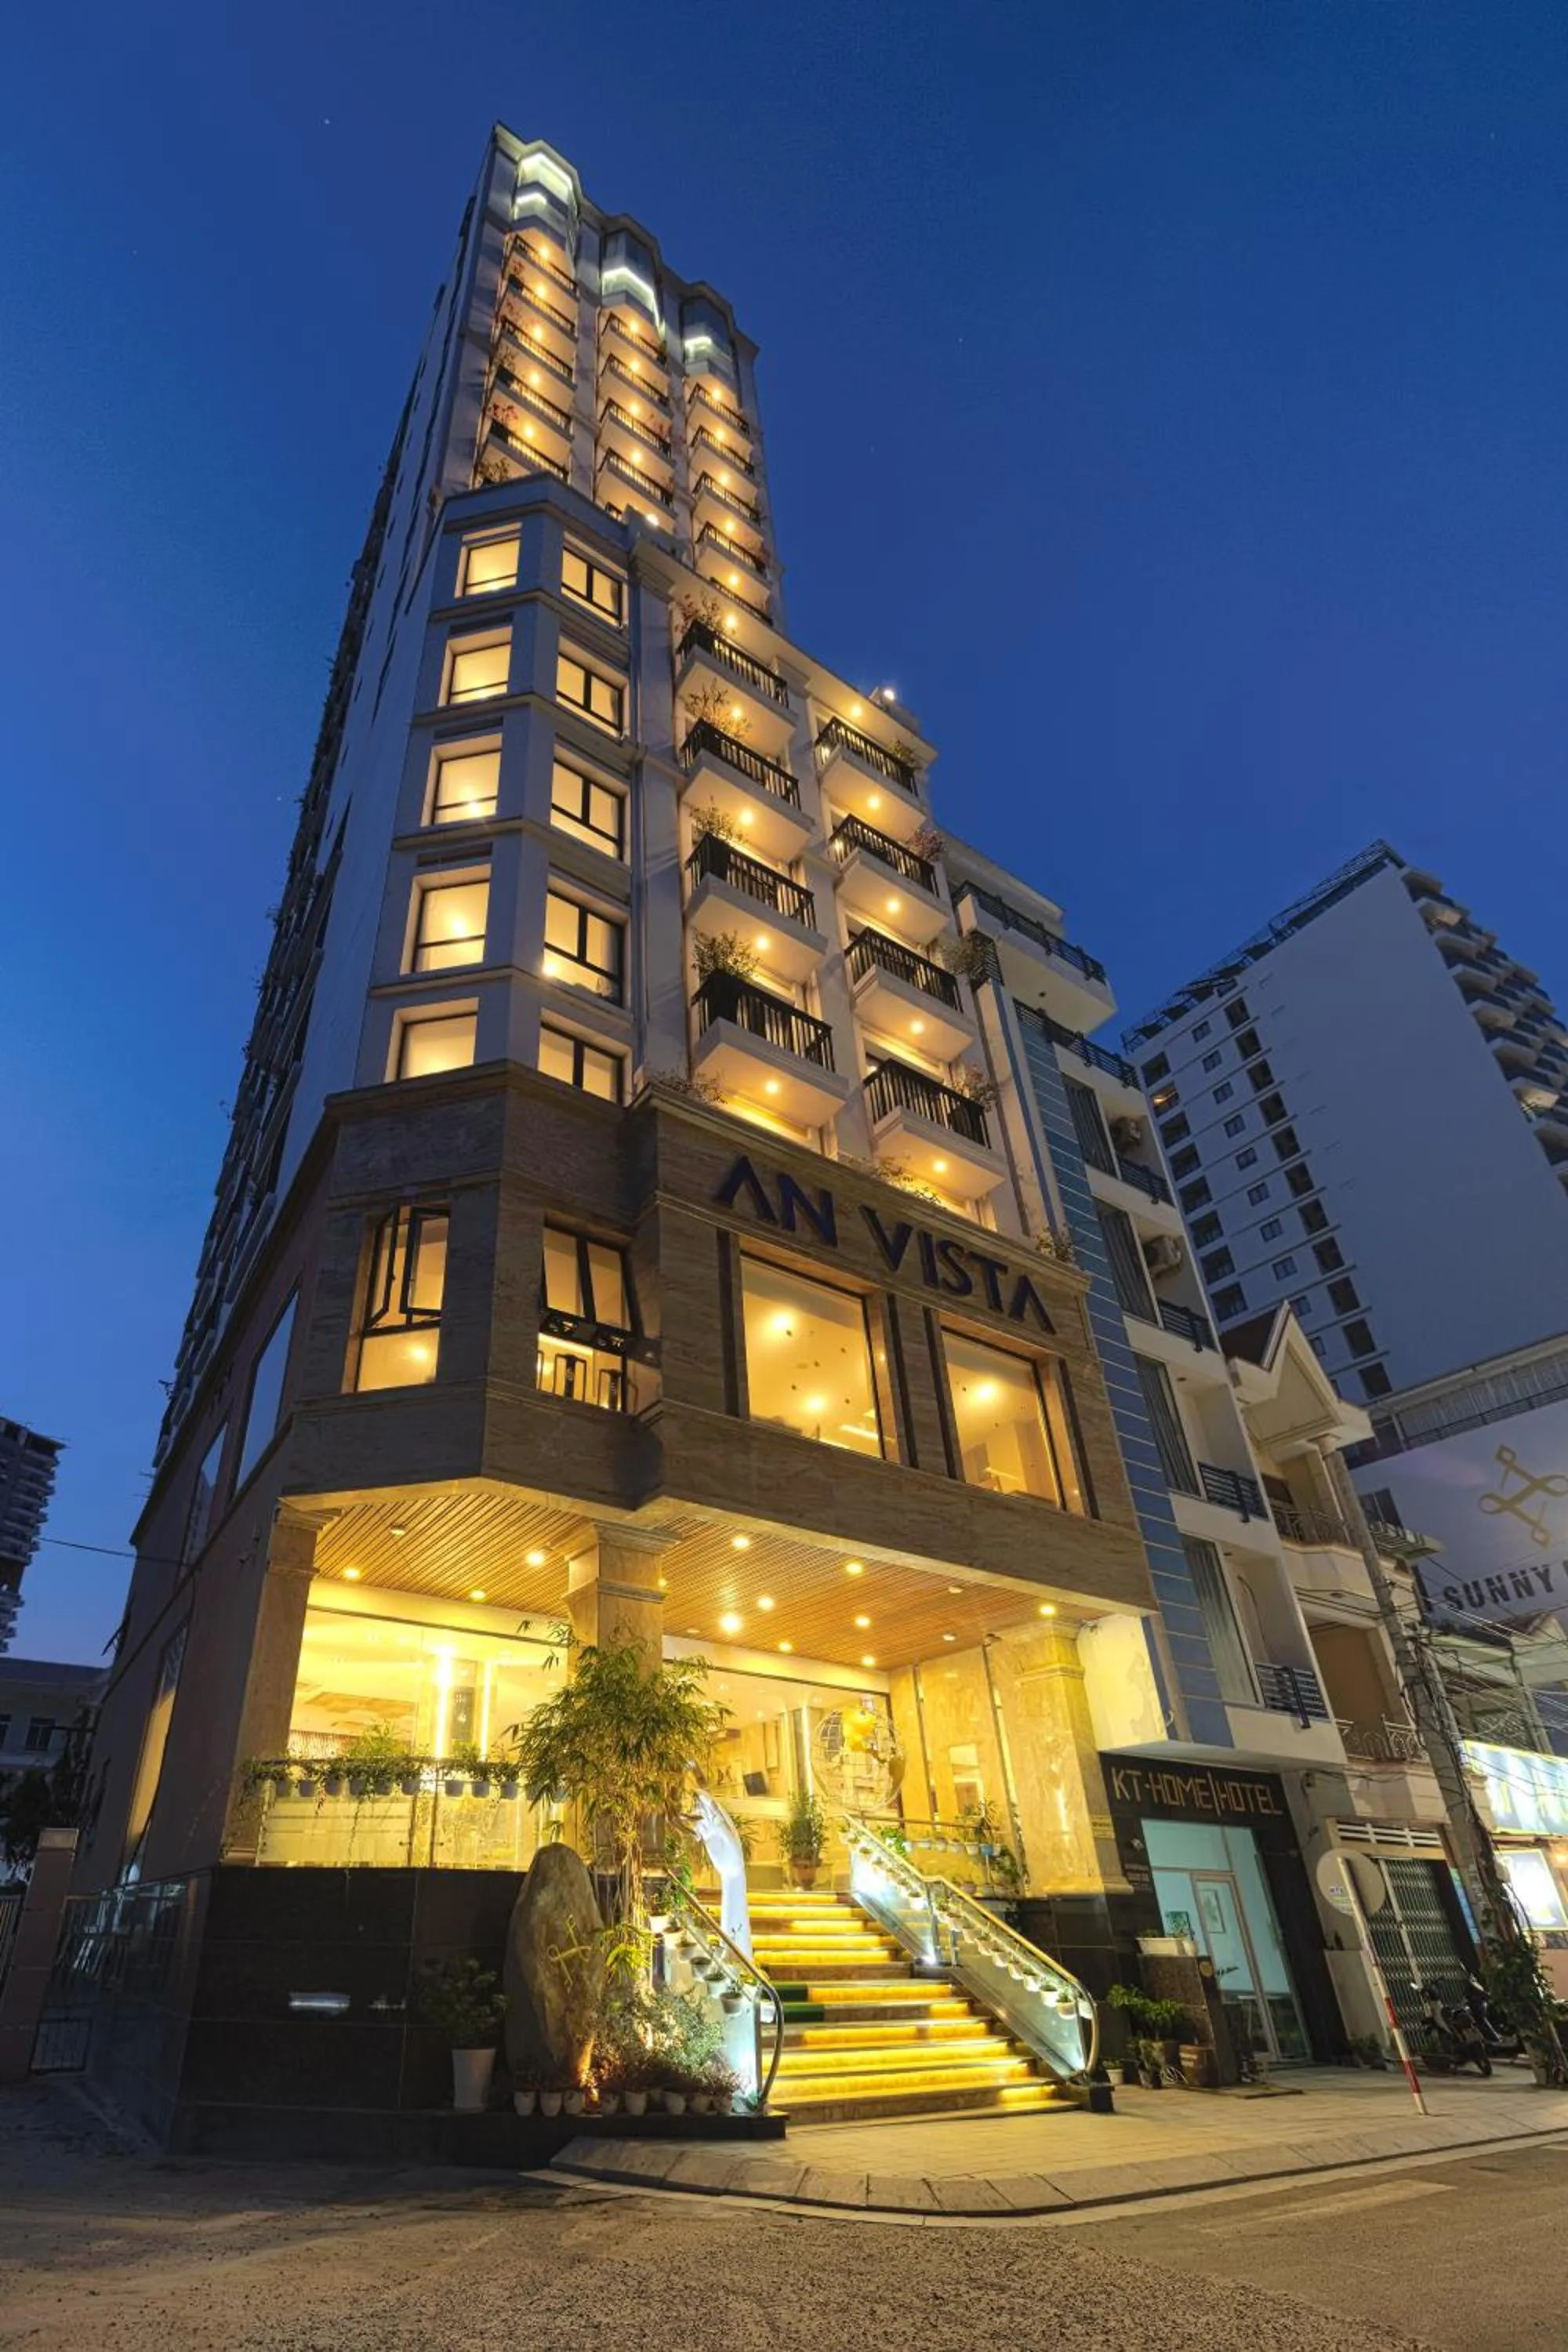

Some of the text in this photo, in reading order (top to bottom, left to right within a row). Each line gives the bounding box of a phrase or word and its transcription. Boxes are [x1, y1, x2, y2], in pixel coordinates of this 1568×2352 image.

[714, 1156, 1056, 1334] AN VISTA
[1443, 1565, 1554, 1610] SUNNY
